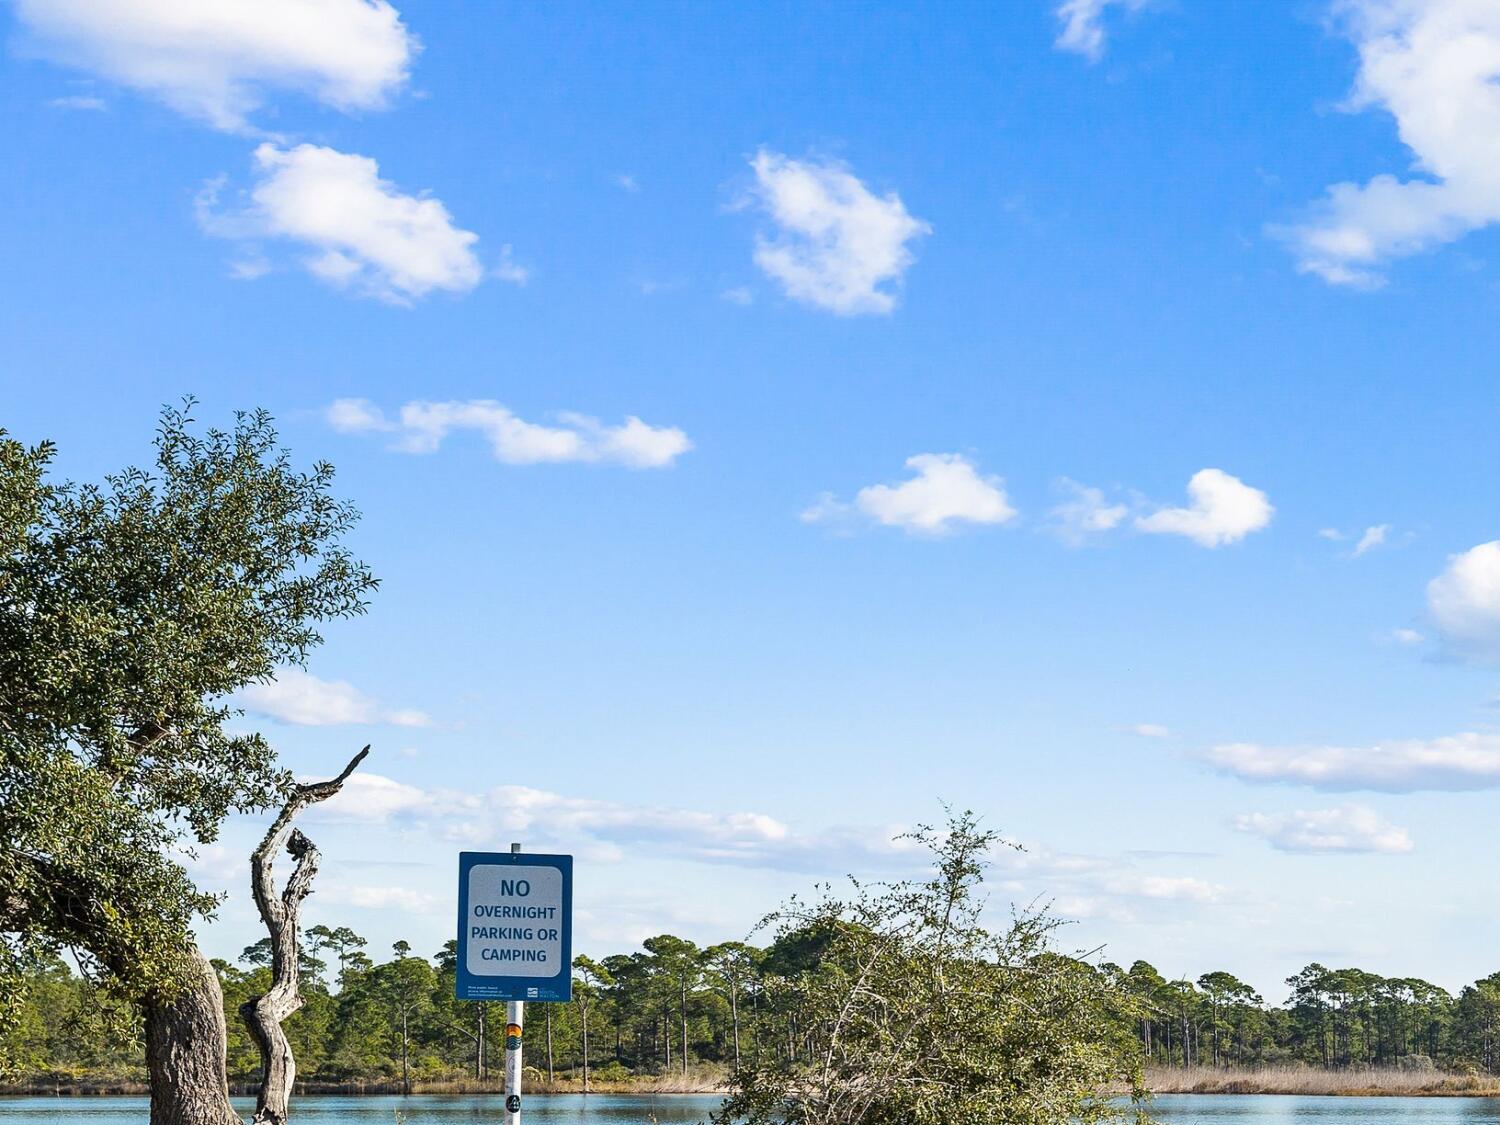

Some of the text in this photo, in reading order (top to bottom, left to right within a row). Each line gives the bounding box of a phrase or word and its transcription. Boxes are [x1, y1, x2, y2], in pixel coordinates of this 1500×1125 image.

[501, 879, 531, 897] NO
[474, 905, 556, 919] OVERNIGHT
[471, 926, 558, 941] PARKING OR
[481, 948, 547, 962] CAMPING
